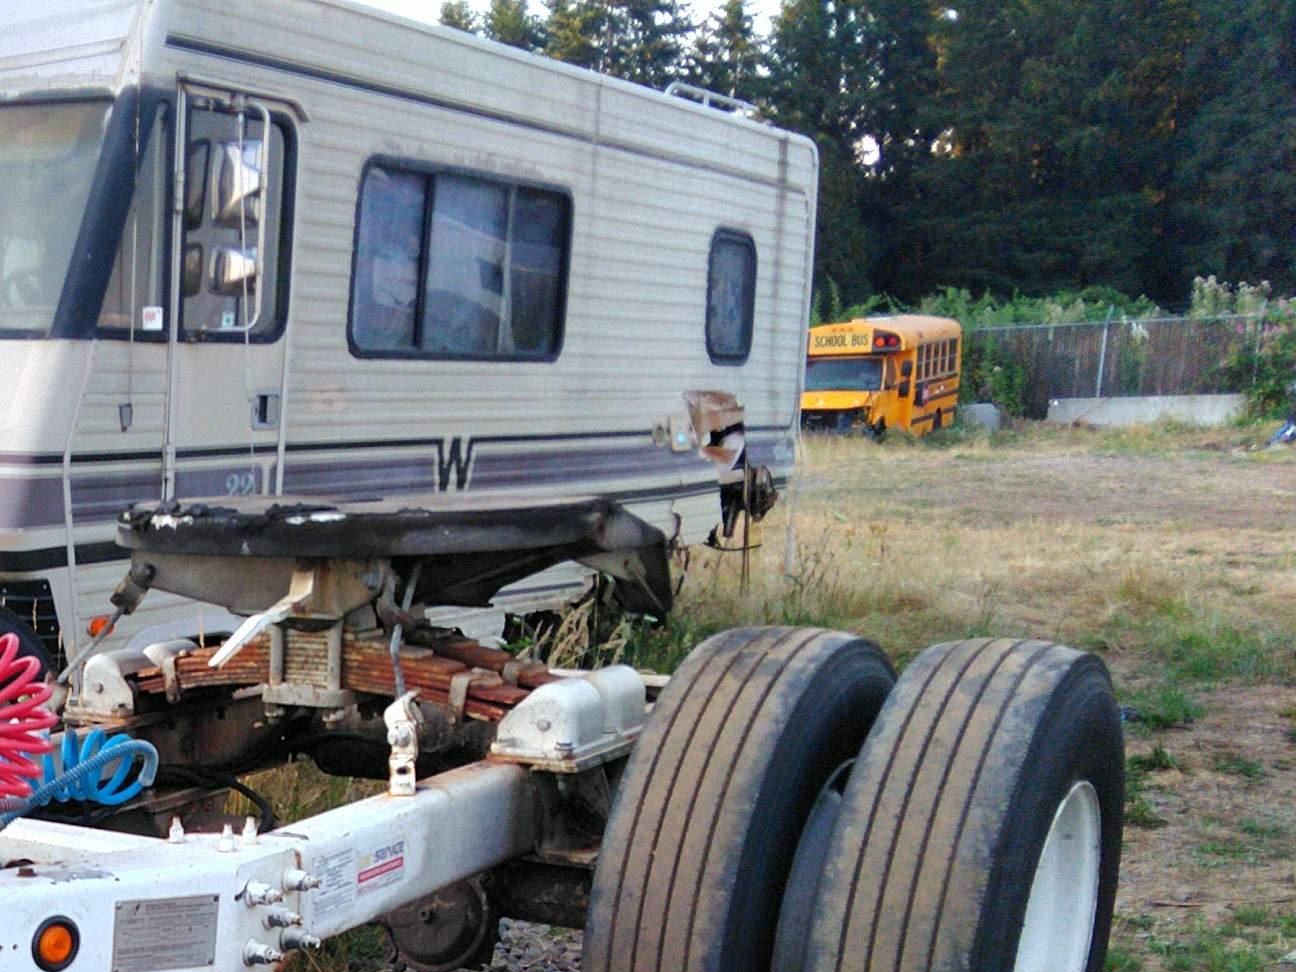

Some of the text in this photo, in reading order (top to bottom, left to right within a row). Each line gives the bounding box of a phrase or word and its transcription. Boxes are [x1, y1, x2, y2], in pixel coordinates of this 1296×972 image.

[815, 334, 869, 348] SCHOOL BUS
[437, 437, 474, 491] W
